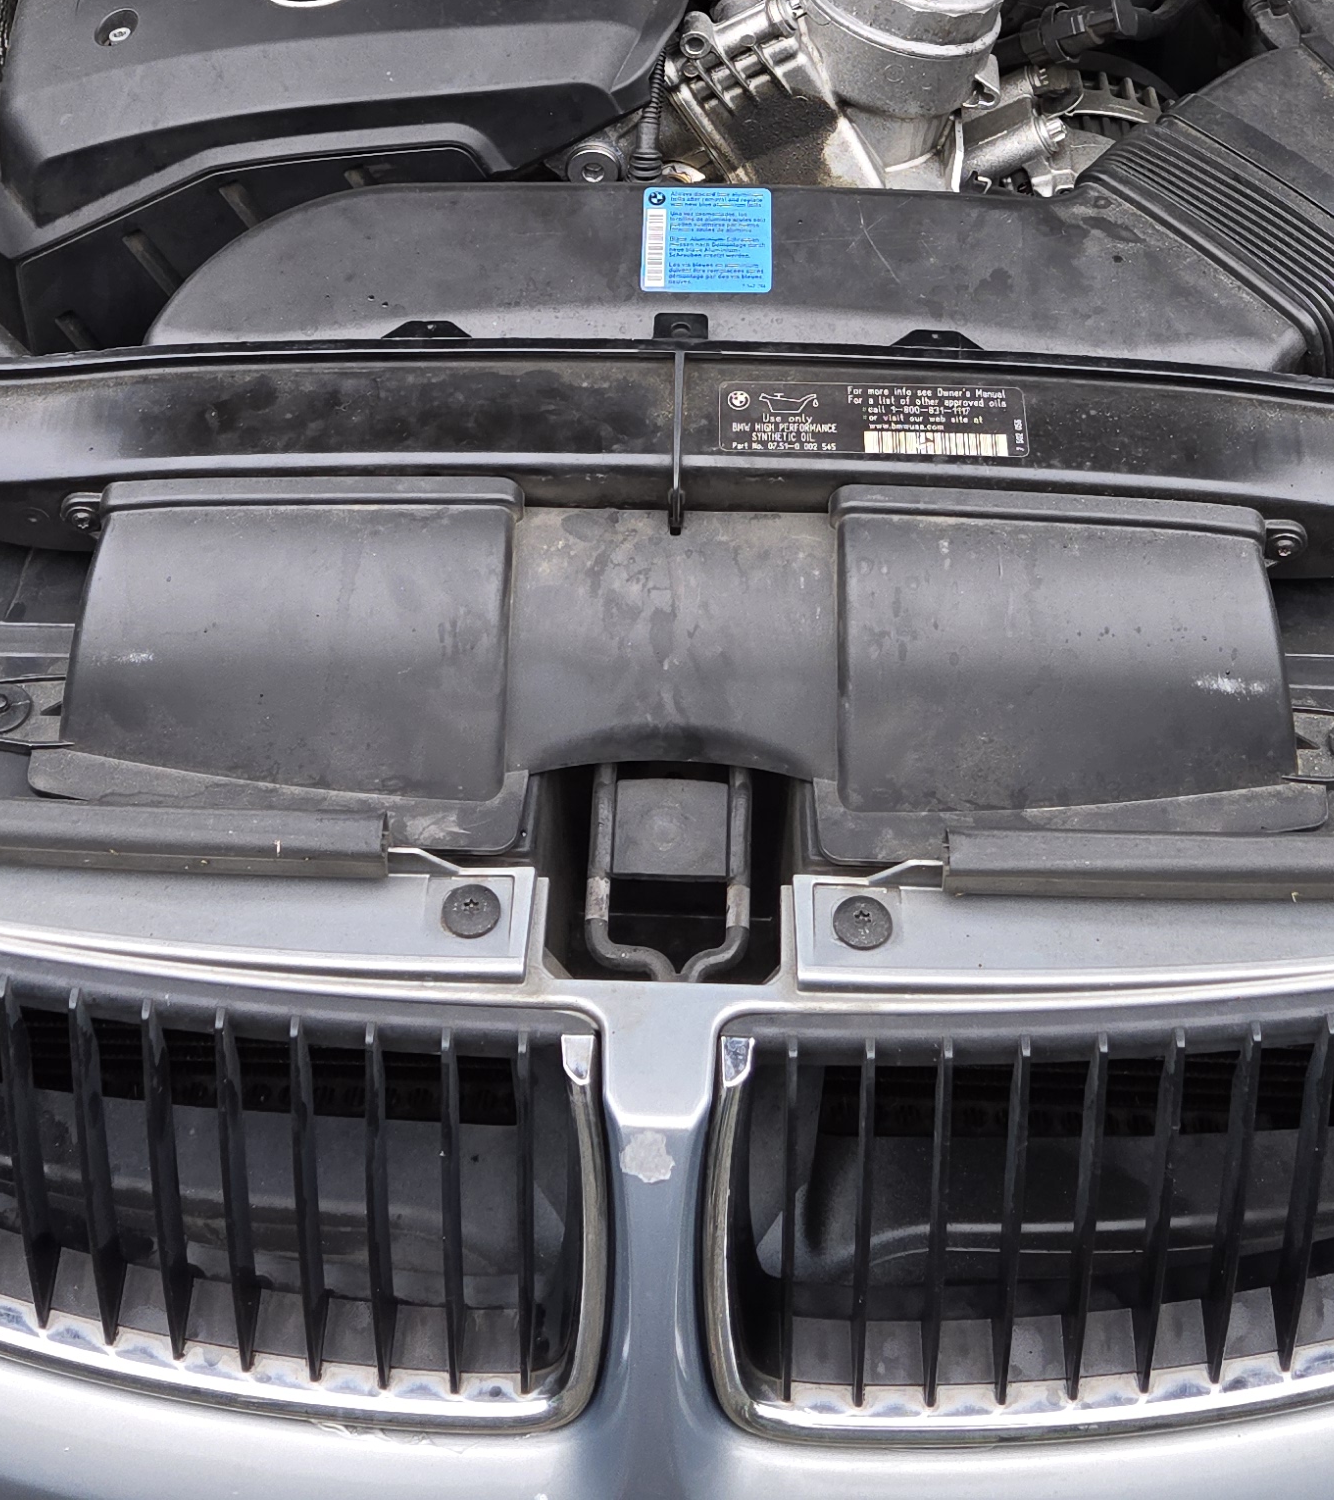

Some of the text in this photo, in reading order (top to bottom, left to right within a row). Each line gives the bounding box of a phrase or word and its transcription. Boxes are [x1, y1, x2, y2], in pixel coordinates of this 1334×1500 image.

[847, 386, 863, 395] For
[867, 388, 889, 396] more
[894, 386, 912, 396] info
[937, 387, 970, 397] Owner's
[975, 388, 1006, 399] Manual
[847, 395, 1007, 408] For a list of other approved oils
[868, 405, 885, 414] call
[762, 412, 813, 425] Use only
[883, 414, 904, 422] visit
[929, 415, 946, 423] web
[951, 416, 968, 424] site
[973, 416, 983, 424] at
[732, 422, 838, 433] BMW HIGH PERFORMANCE
[752, 431, 816, 442] SYNTHETIC OIL
[752, 442, 764, 450] No.
